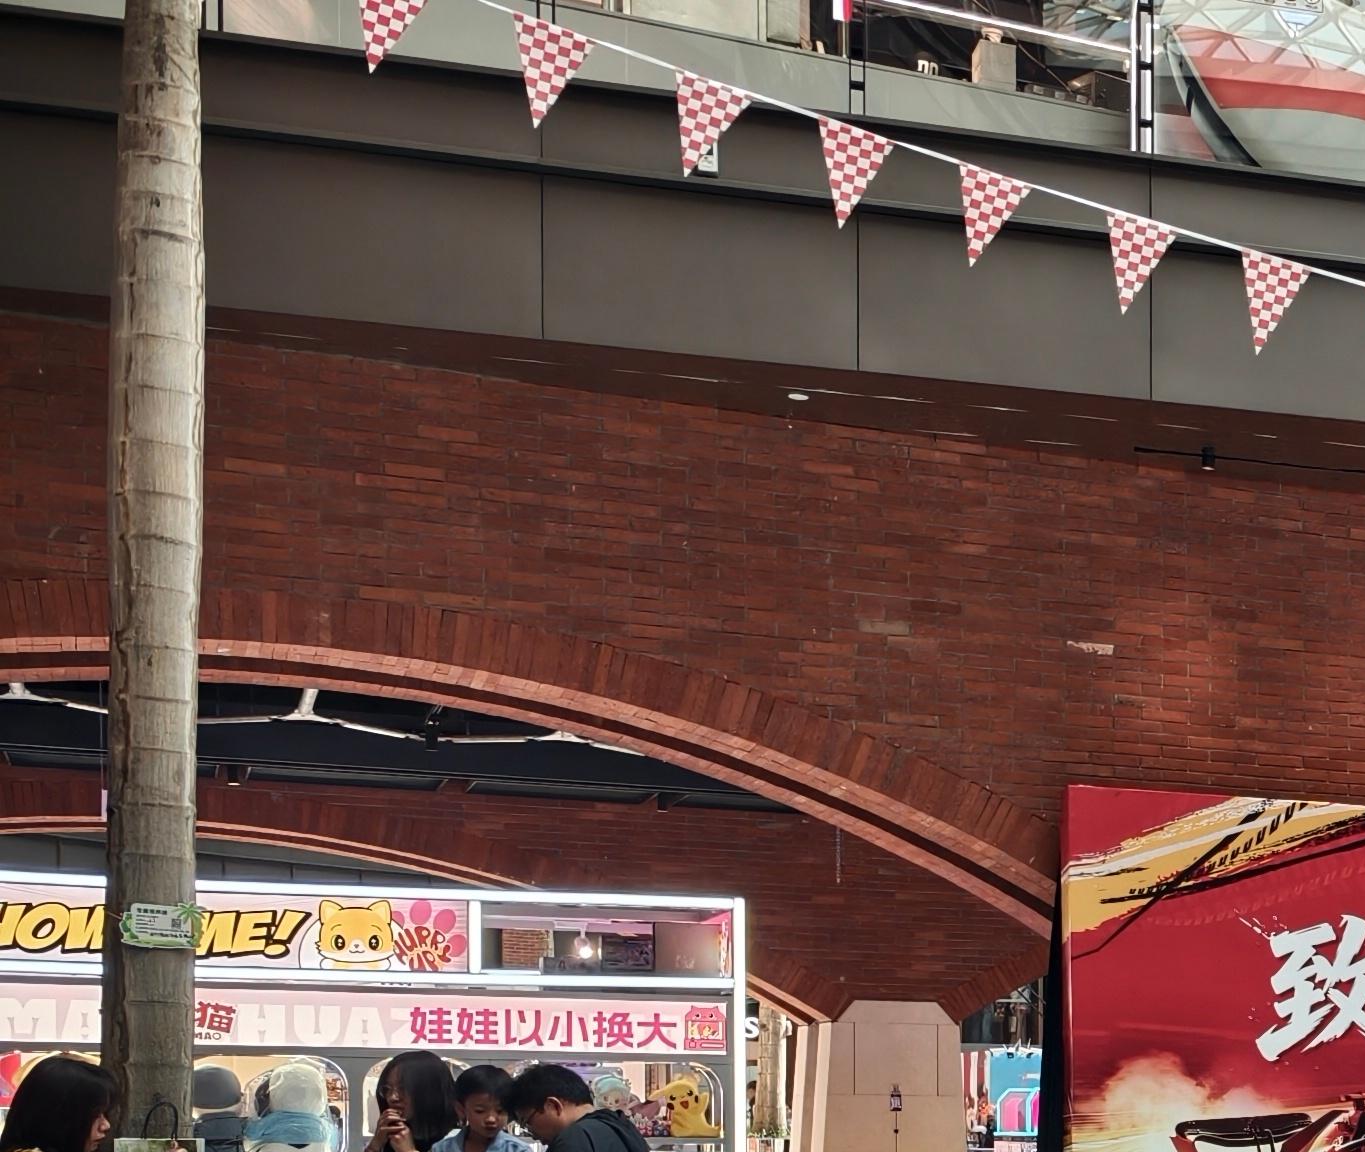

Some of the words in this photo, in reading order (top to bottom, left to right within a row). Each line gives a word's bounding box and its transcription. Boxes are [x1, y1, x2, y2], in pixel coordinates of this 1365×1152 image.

[410, 1006, 677, 1050] 娃娃以小换大
